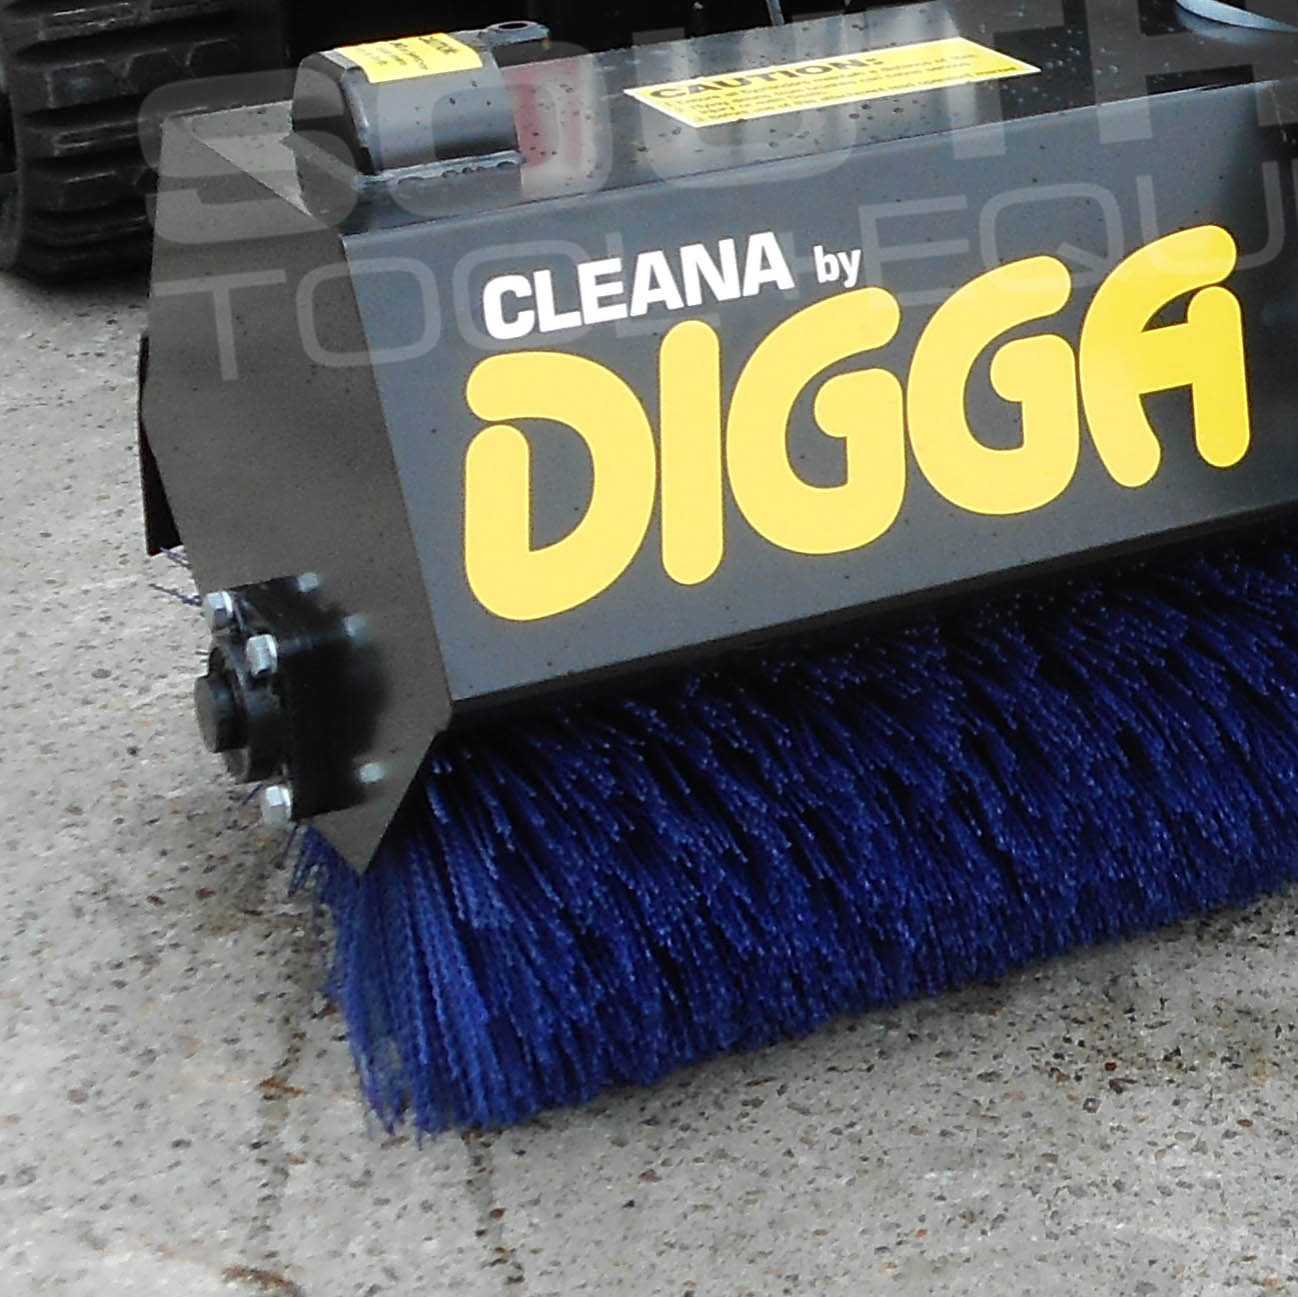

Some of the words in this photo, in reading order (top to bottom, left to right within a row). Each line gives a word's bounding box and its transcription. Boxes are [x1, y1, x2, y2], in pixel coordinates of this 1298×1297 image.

[649, 56, 882, 99] CAUTION:
[481, 231, 795, 340] CLEANA
[813, 245, 863, 288] by
[464, 224, 1251, 622] DIGGA
